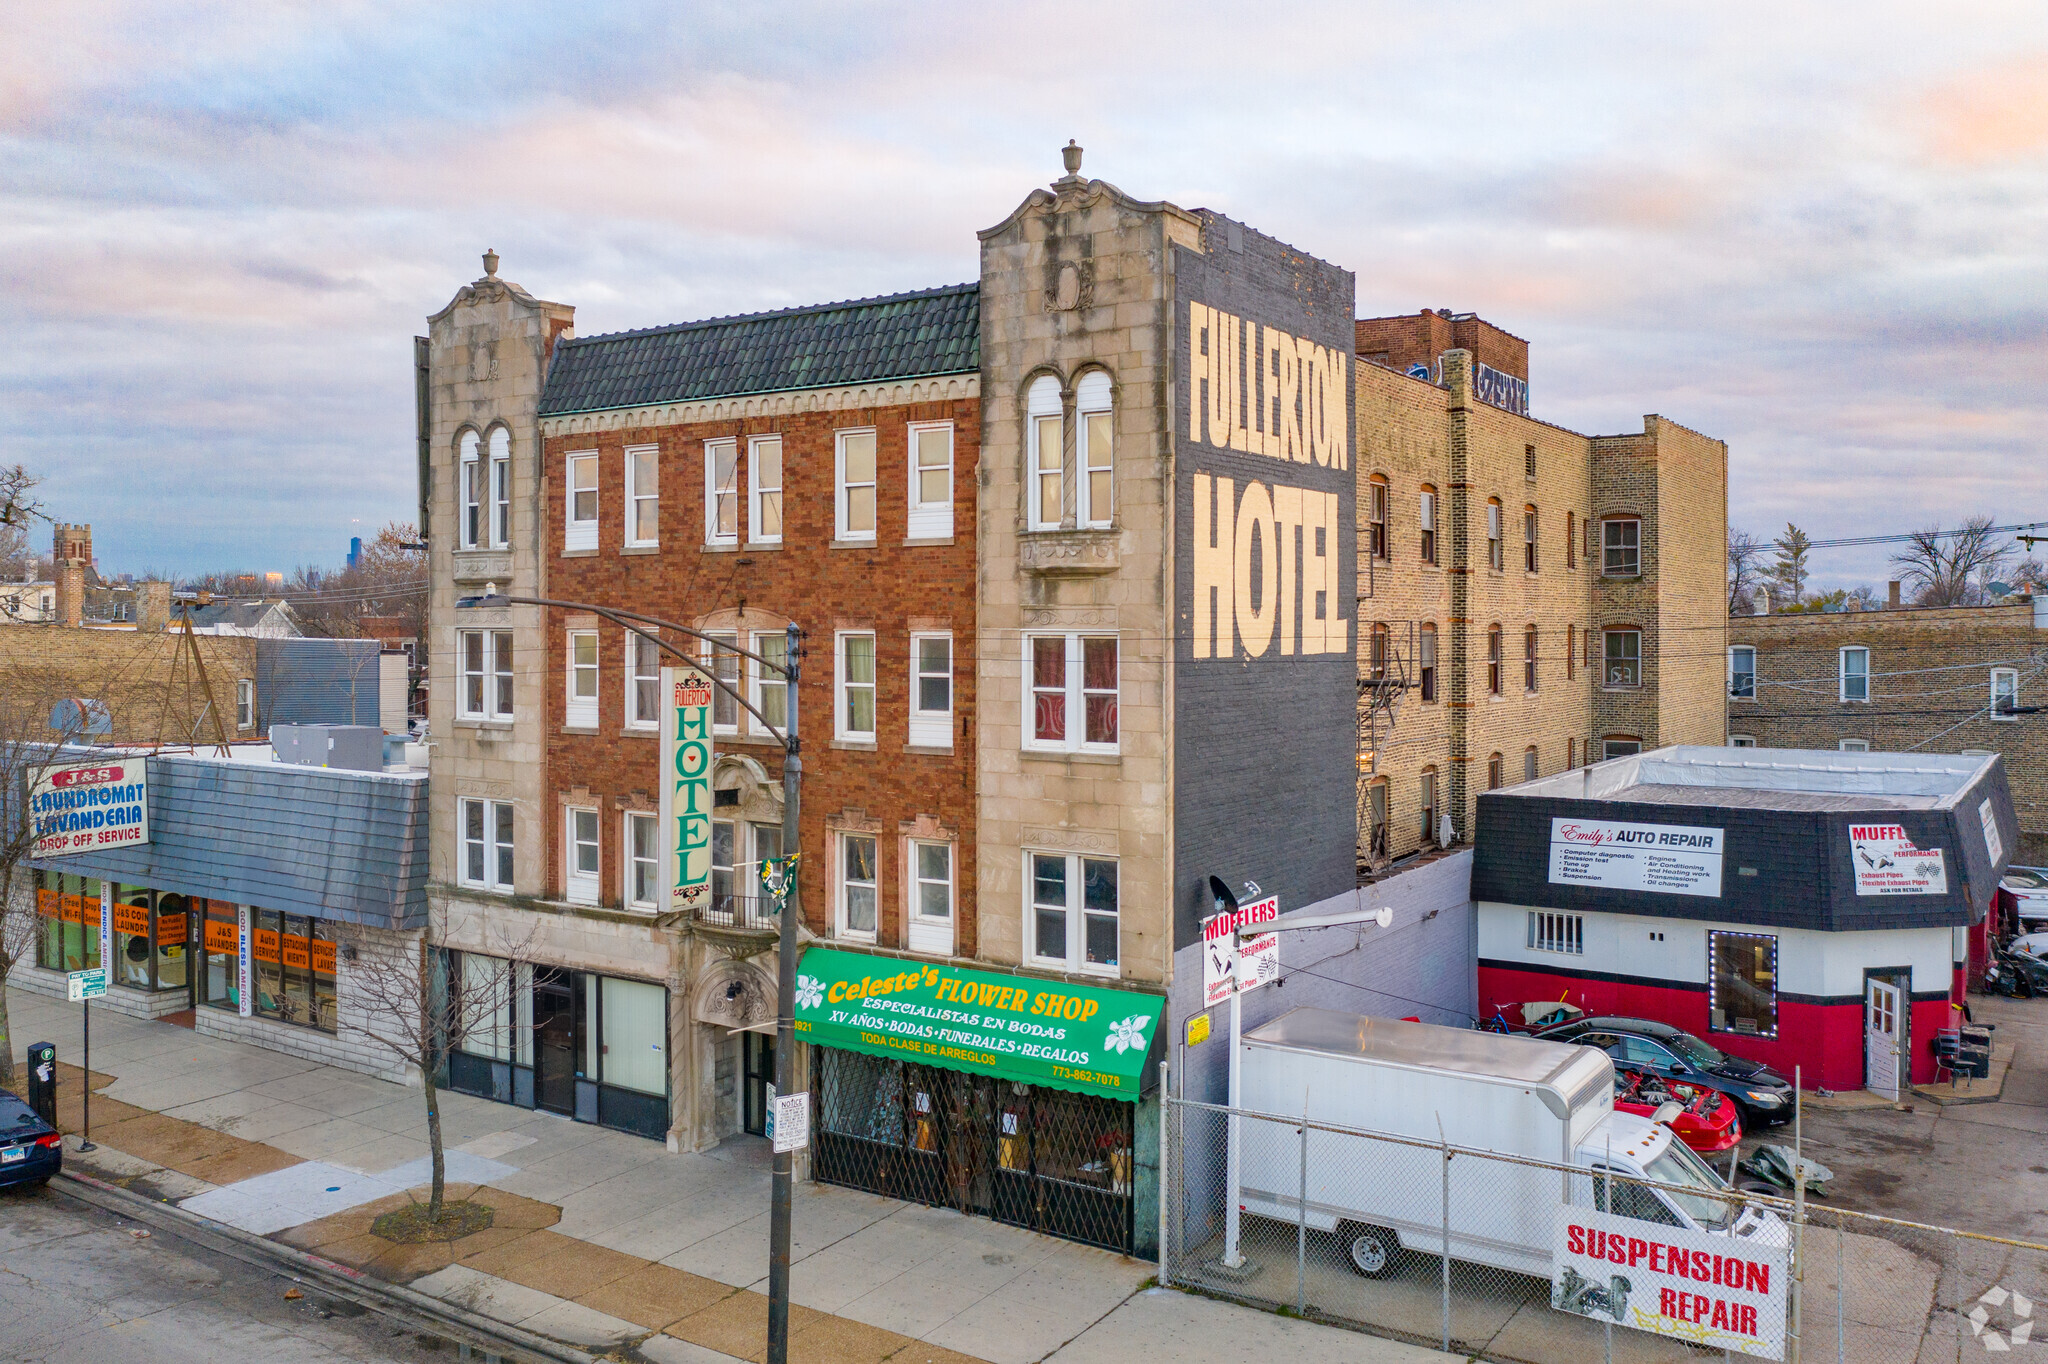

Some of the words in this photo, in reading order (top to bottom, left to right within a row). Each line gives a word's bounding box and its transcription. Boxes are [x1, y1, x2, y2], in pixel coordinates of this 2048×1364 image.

[1189, 300, 1348, 471] FULLERTON
[1193, 473, 1348, 659] HOTEL
[675, 690, 711, 706] FULLERTON
[32, 783, 144, 813] LAUNDROMAT
[674, 707, 709, 887] HOTEL
[36, 805, 142, 833] LAVANDERIA
[40, 836, 68, 851] DROP
[73, 833, 92, 847] OFF
[98, 827, 140, 844] SERVICE
[1560, 824, 1613, 848] Emily's
[1616, 830, 1655, 844] AUTO
[1658, 833, 1714, 848] REPAIR
[1852, 826, 1906, 841] MUFFL
[1564, 849, 1597, 858] Computer
[1598, 852, 1635, 860] diagnostic
[1648, 855, 1677, 863] Engines
[1660, 862, 1704, 871] Conditioning
[1662, 869, 1691, 877] Heating
[1692, 870, 1710, 878] work
[1562, 873, 1602, 881] Suspension
[1647, 873, 1699, 883] Transmissions
[1658, 880, 1689, 888] changes
[64, 897, 79, 908] Free
[85, 913, 101, 925] Servic
[116, 907, 129, 918] J&S
[131, 909, 149, 921] COIN
[116, 920, 149, 934] LAUNDRY
[217, 926, 232, 938] J&S
[260, 933, 276, 946] Auto
[1241, 937, 1276, 958] ERFORMANCE
[827, 965, 939, 1004] Celeste's
[935, 978, 1029, 1012] FLOWER
[1030, 992, 1099, 1022] SHOP
[862, 997, 981, 1026] ESPECIALISTAS
[982, 1016, 1006, 1031] EN
[1008, 1020, 1067, 1040] BODAS
[829, 1010, 849, 1023] XV
[848, 1012, 885, 1030] AÑOS
[888, 1020, 933, 1038] BODAS
[938, 1028, 1017, 1054] FUNERALES
[1020, 1043, 1090, 1065] REGALOS
[860, 1031, 887, 1046] TODA
[889, 1036, 921, 1052] CLASE
[923, 1042, 938, 1055] DE
[939, 1046, 996, 1066] ARREGLOS
[1052, 1065, 1121, 1087] 773-862-7078
[781, 1098, 803, 1108] NOTICE
[1567, 1224, 1770, 1295] SUSPENSION
[1659, 1286, 1758, 1337] REPAIR
